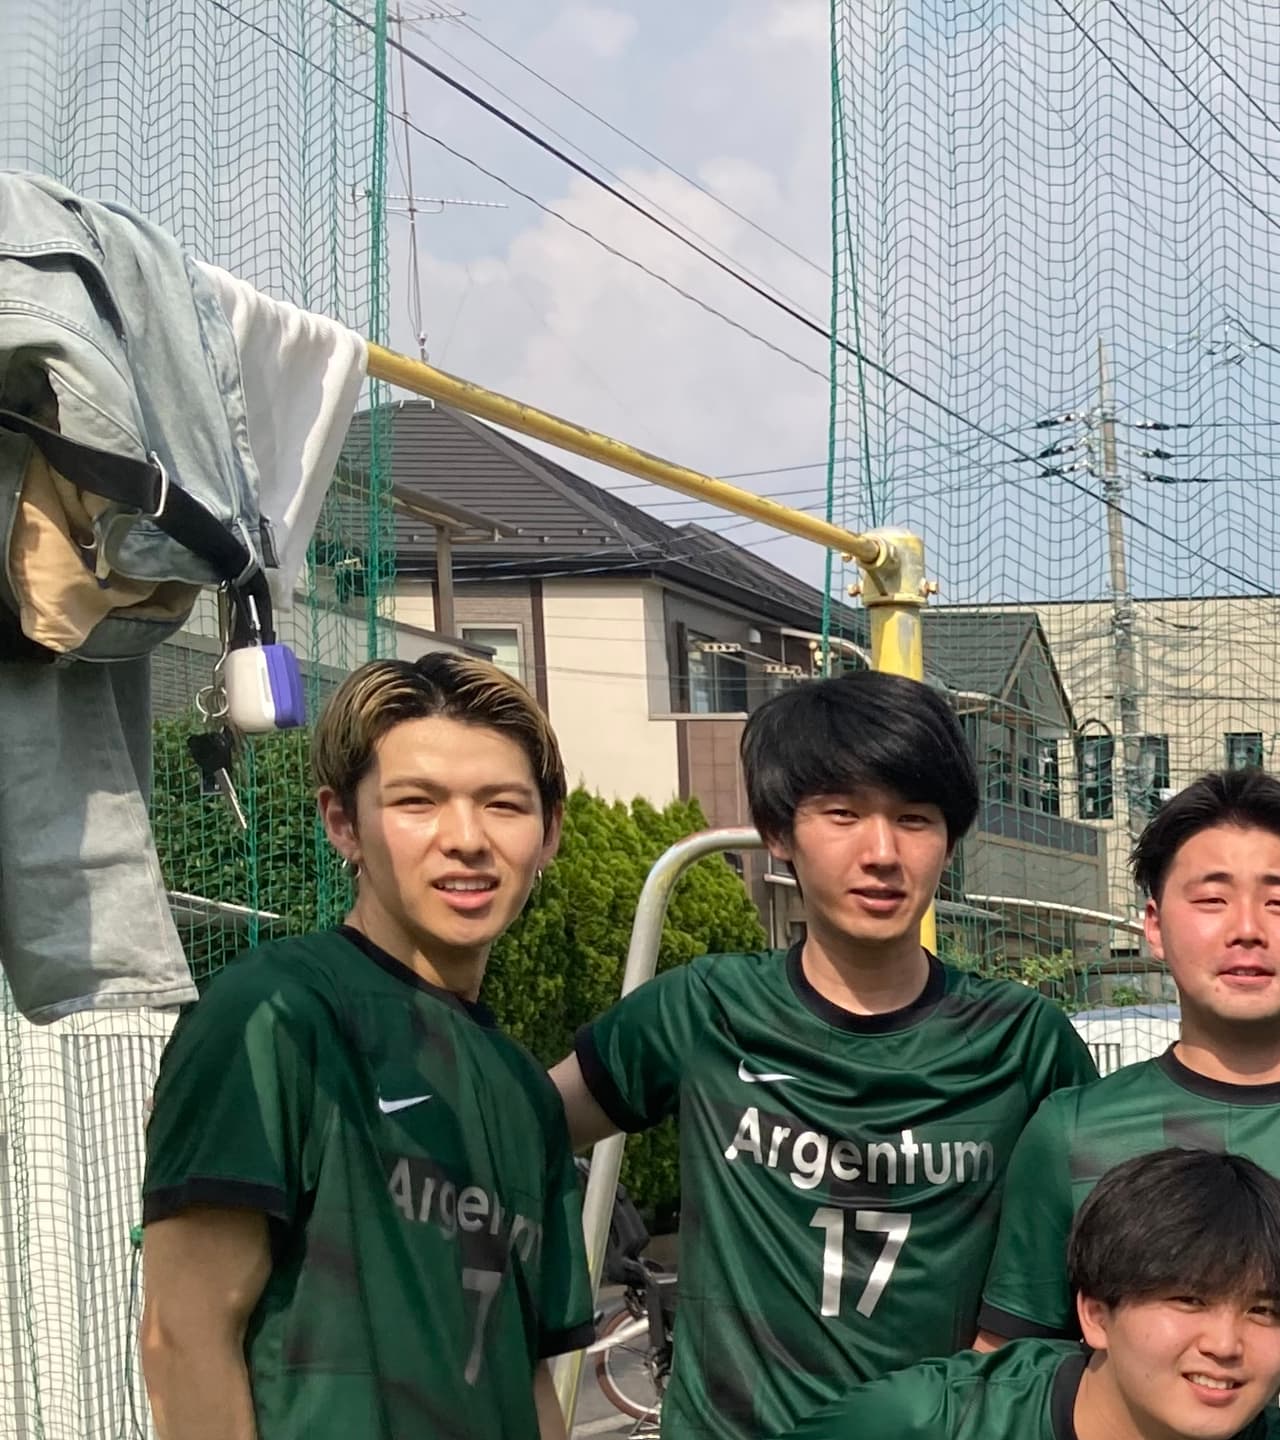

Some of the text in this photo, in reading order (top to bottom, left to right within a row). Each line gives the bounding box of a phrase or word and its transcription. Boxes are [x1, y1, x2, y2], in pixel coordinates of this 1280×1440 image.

[725, 1107, 994, 1190] Argentum
[809, 1207, 912, 1318] 17
[462, 1268, 503, 1386] 7
